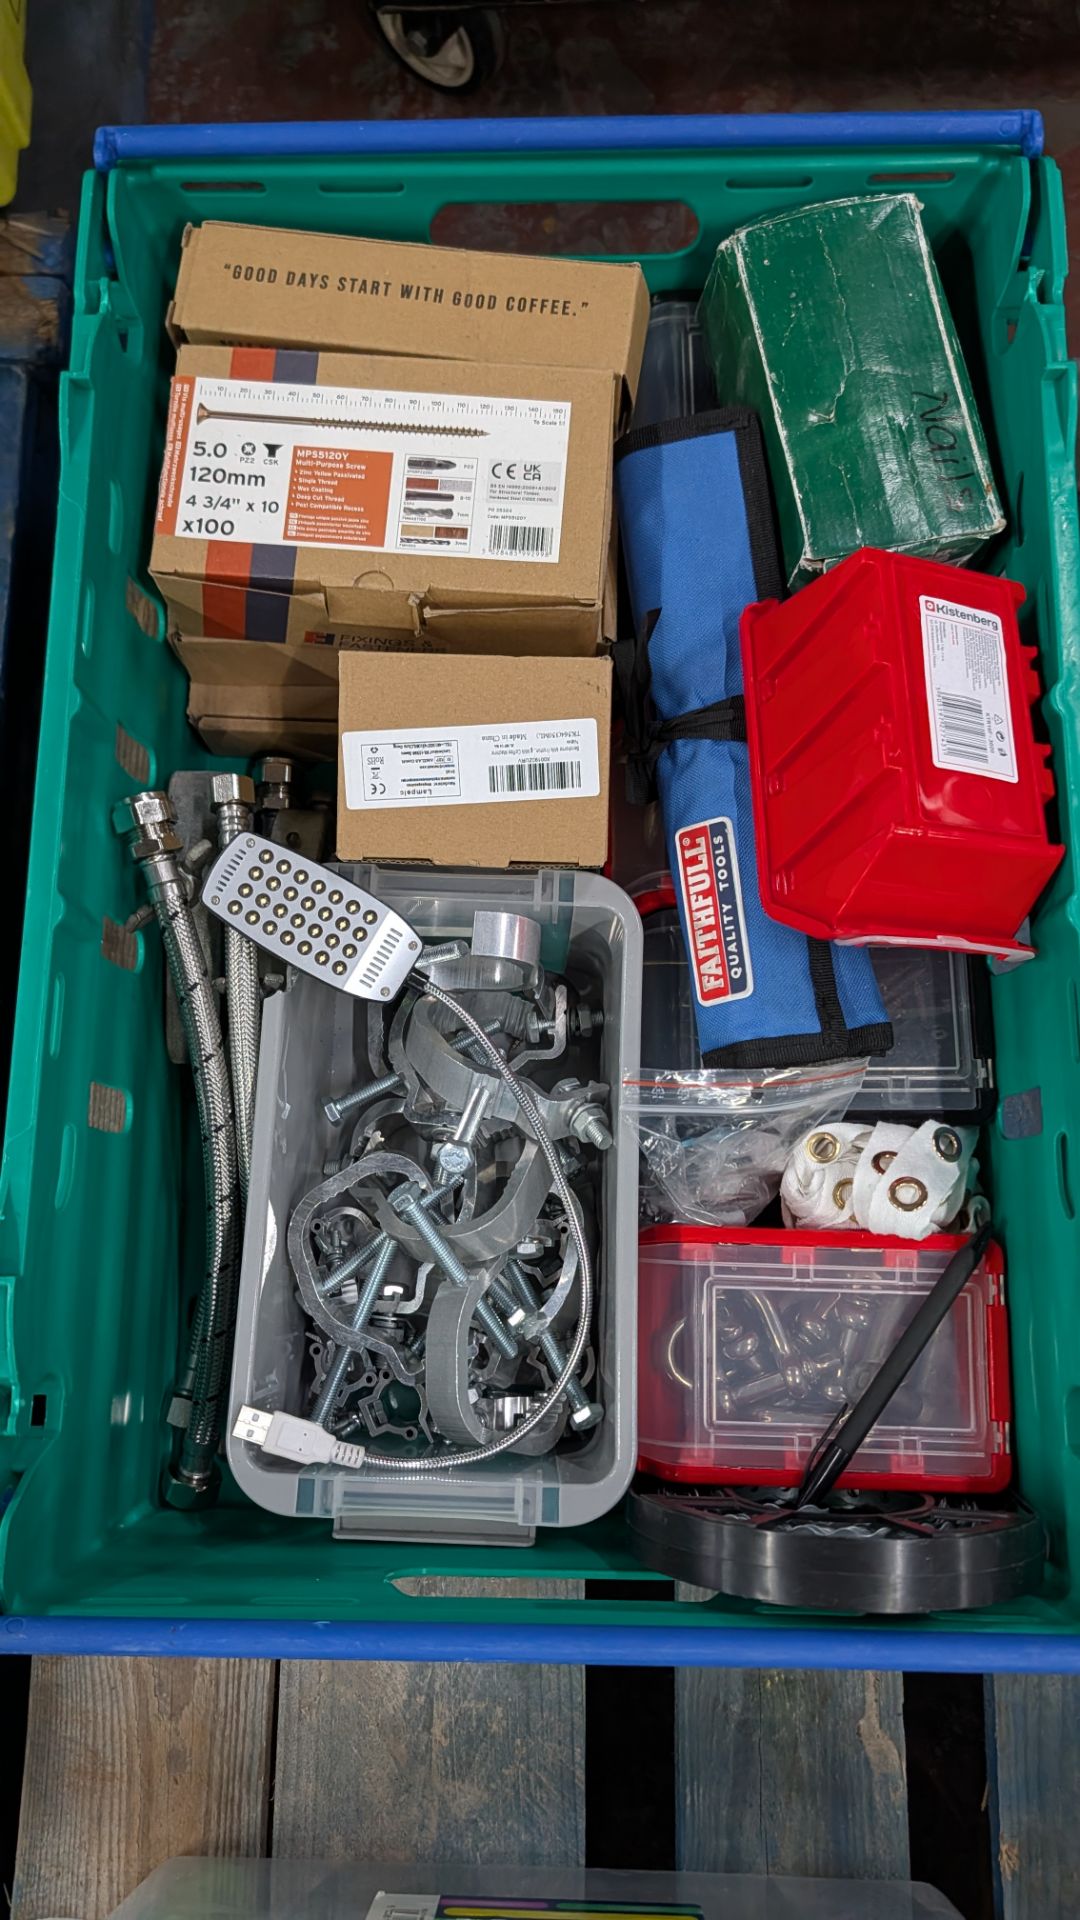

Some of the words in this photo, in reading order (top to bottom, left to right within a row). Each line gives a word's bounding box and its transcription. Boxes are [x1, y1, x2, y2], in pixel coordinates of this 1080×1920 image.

[285, 270, 330, 292] DAYS
[337, 276, 391, 297] START
[400, 283, 443, 305] WITH
[452, 291, 497, 311] GOOD
[193, 441, 228, 459] 5.0
[296, 450, 350, 461] MPS5120Y
[263, 458, 279, 466] CSK
[295, 459, 344, 470] Multi-Purpose
[189, 466, 266, 487] 120mm
[314, 470, 333, 478] Yellow
[334, 472, 365, 480] Passivated
[298, 478, 316, 486] Single
[185, 495, 197, 507] 4
[246, 502, 255, 512] x
[262, 501, 279, 513] 10
[296, 493, 311, 501] Deep
[324, 495, 345, 503] Thread
[182, 518, 235, 536] x100
[936, 604, 999, 631] Kistenberg
[339, 633, 418, 647] FIXINGS
[482, 734, 500, 742] China
[512, 733, 527, 741] Made
[367, 756, 384, 766] RoHS
[713, 835, 729, 891] TOOLS
[722, 903, 743, 979] QUALITY
